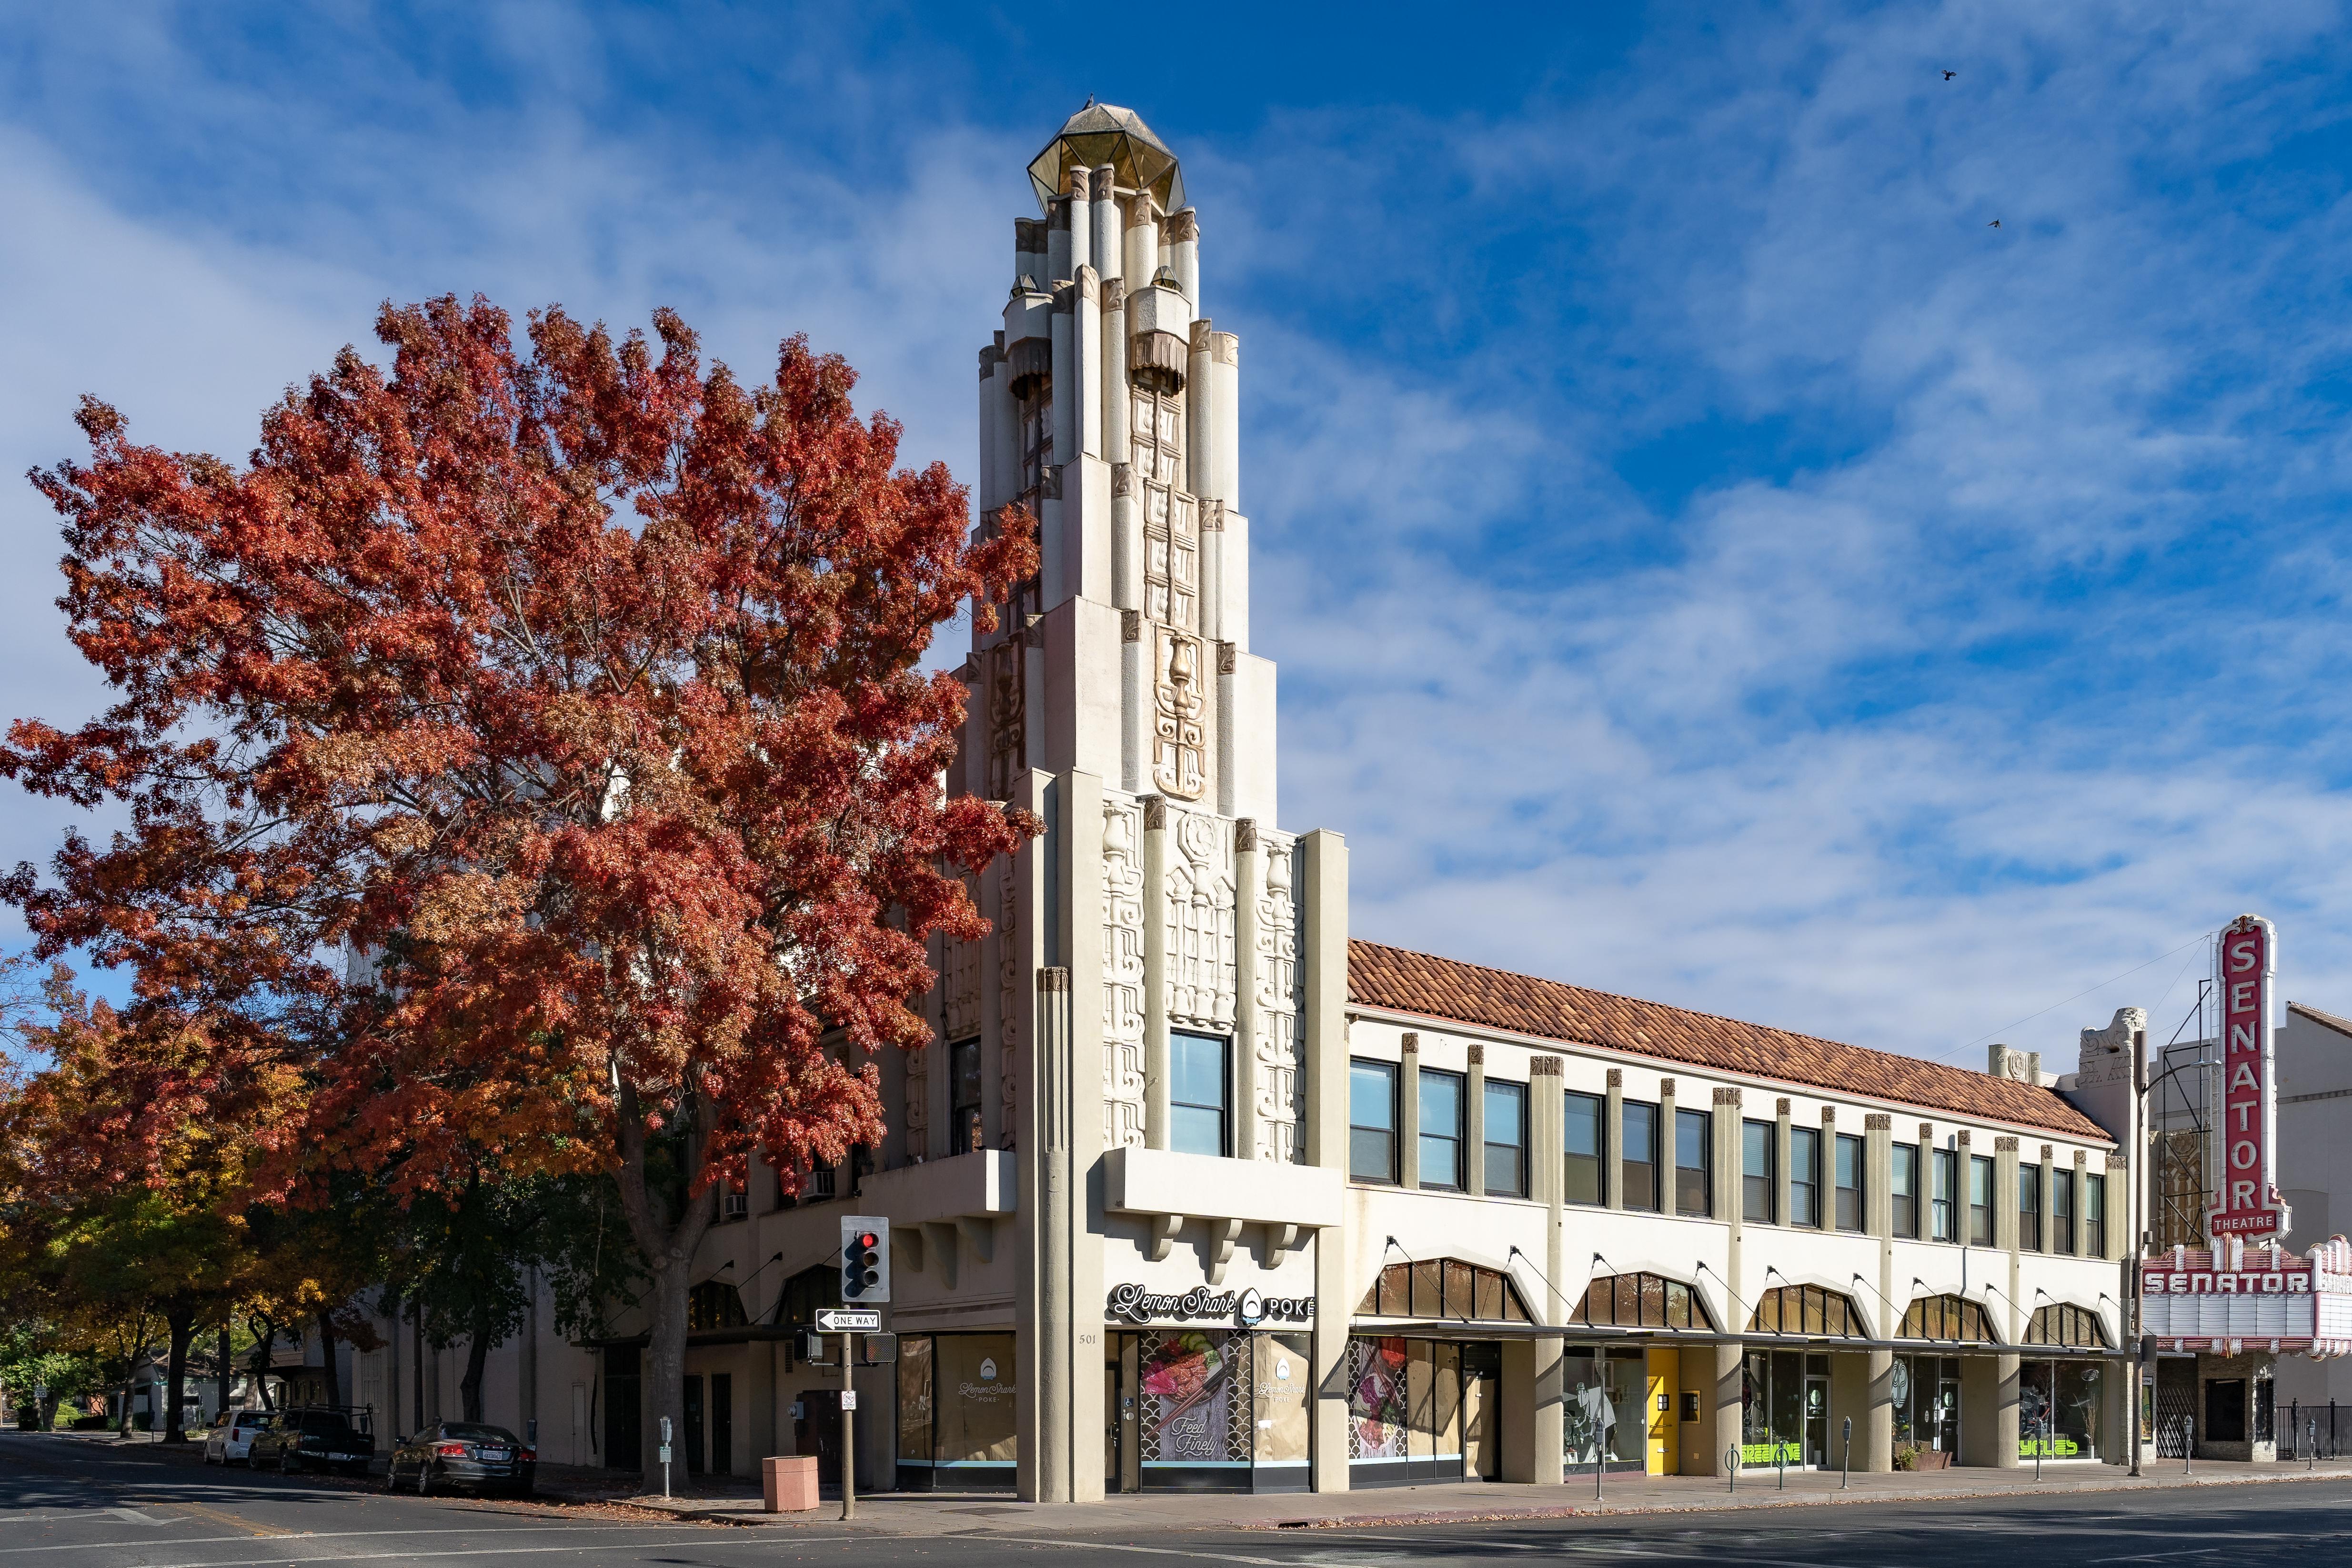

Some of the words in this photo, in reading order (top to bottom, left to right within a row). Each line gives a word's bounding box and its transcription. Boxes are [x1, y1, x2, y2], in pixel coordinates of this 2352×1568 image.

[2227, 940, 2260, 1210] SENATOR
[2215, 1216, 2273, 1230] THEATRE
[2144, 1273, 2308, 1292] SENATOR
[1114, 1285, 1180, 1323] Lemon
[1182, 1287, 1236, 1315] Shark
[834, 1317, 853, 1325] ONE
[1079, 1335, 1096, 1344] 501
[958, 1383, 989, 1398] Lemon
[989, 1383, 1016, 1395] Shark
[1259, 1382, 1284, 1398] Lemon
[1283, 1383, 1305, 1395] Shark
[1171, 1417, 1207, 1435] Feed
[1176, 1434, 1218, 1456] Finely
[2019, 1439, 2078, 1456] YCLES
